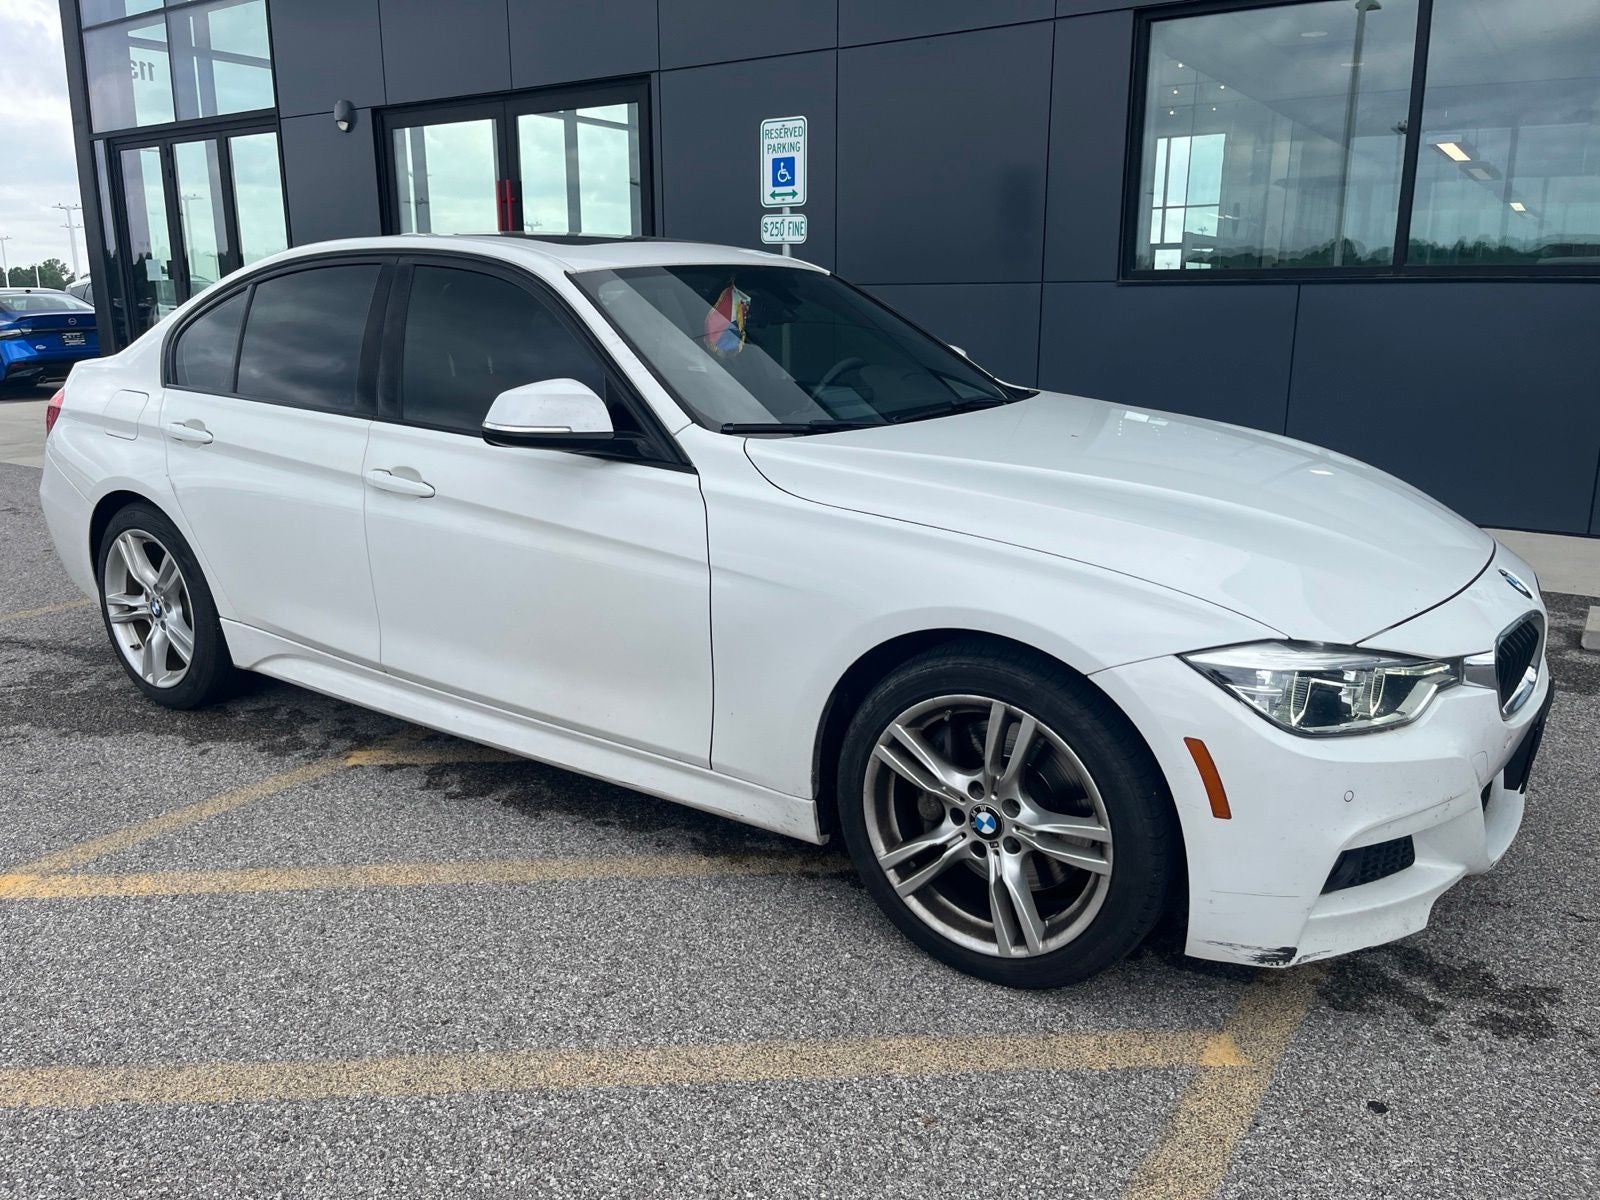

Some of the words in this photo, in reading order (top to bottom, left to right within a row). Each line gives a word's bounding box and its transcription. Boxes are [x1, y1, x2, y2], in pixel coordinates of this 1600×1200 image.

[764, 126, 804, 140] RESERVED
[767, 141, 801, 154] PARKING
[763, 221, 785, 237] $250
[787, 221, 805, 237] FINE
